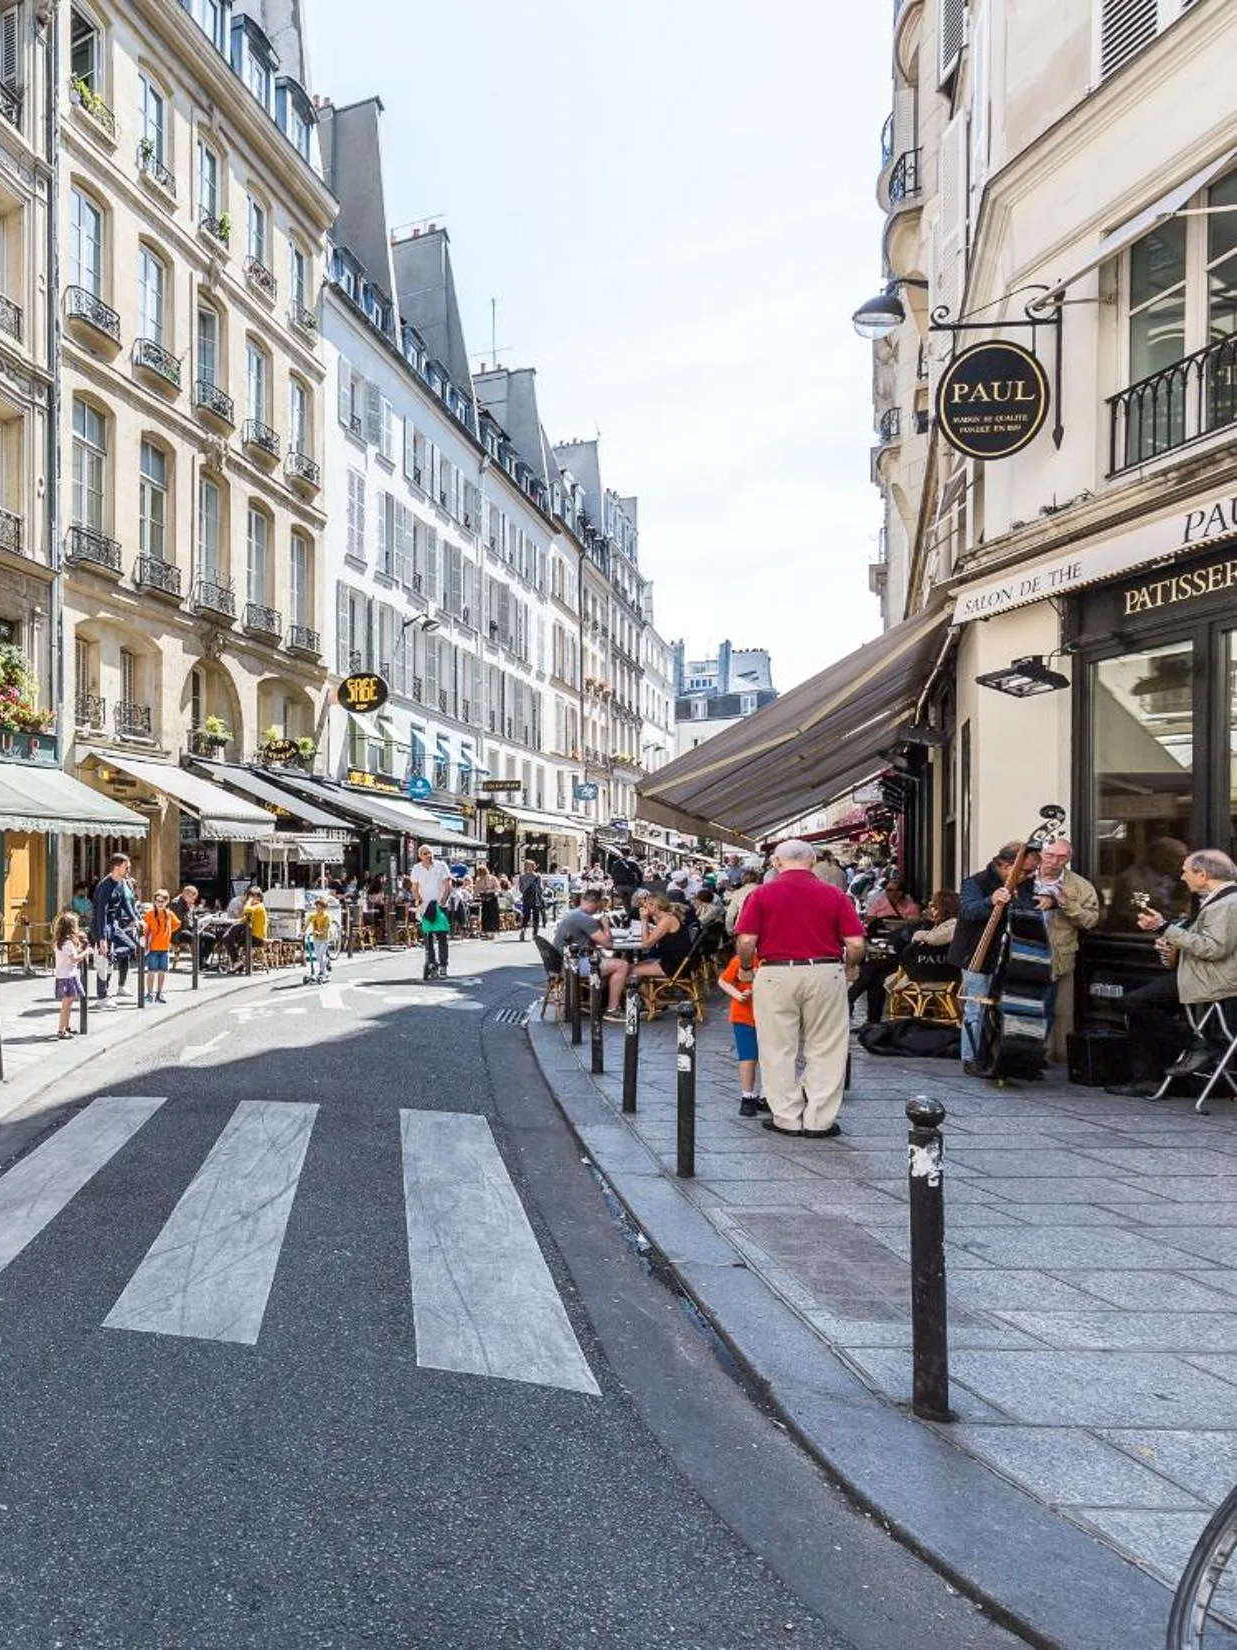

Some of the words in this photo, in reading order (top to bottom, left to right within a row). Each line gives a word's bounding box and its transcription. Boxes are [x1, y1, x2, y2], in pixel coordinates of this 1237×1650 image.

[950, 380, 1035, 403] PAUL
[964, 585, 1014, 615] SALON
[1020, 575, 1042, 597] DE
[1048, 562, 1082, 586] THE
[917, 954, 946, 965] PAU
